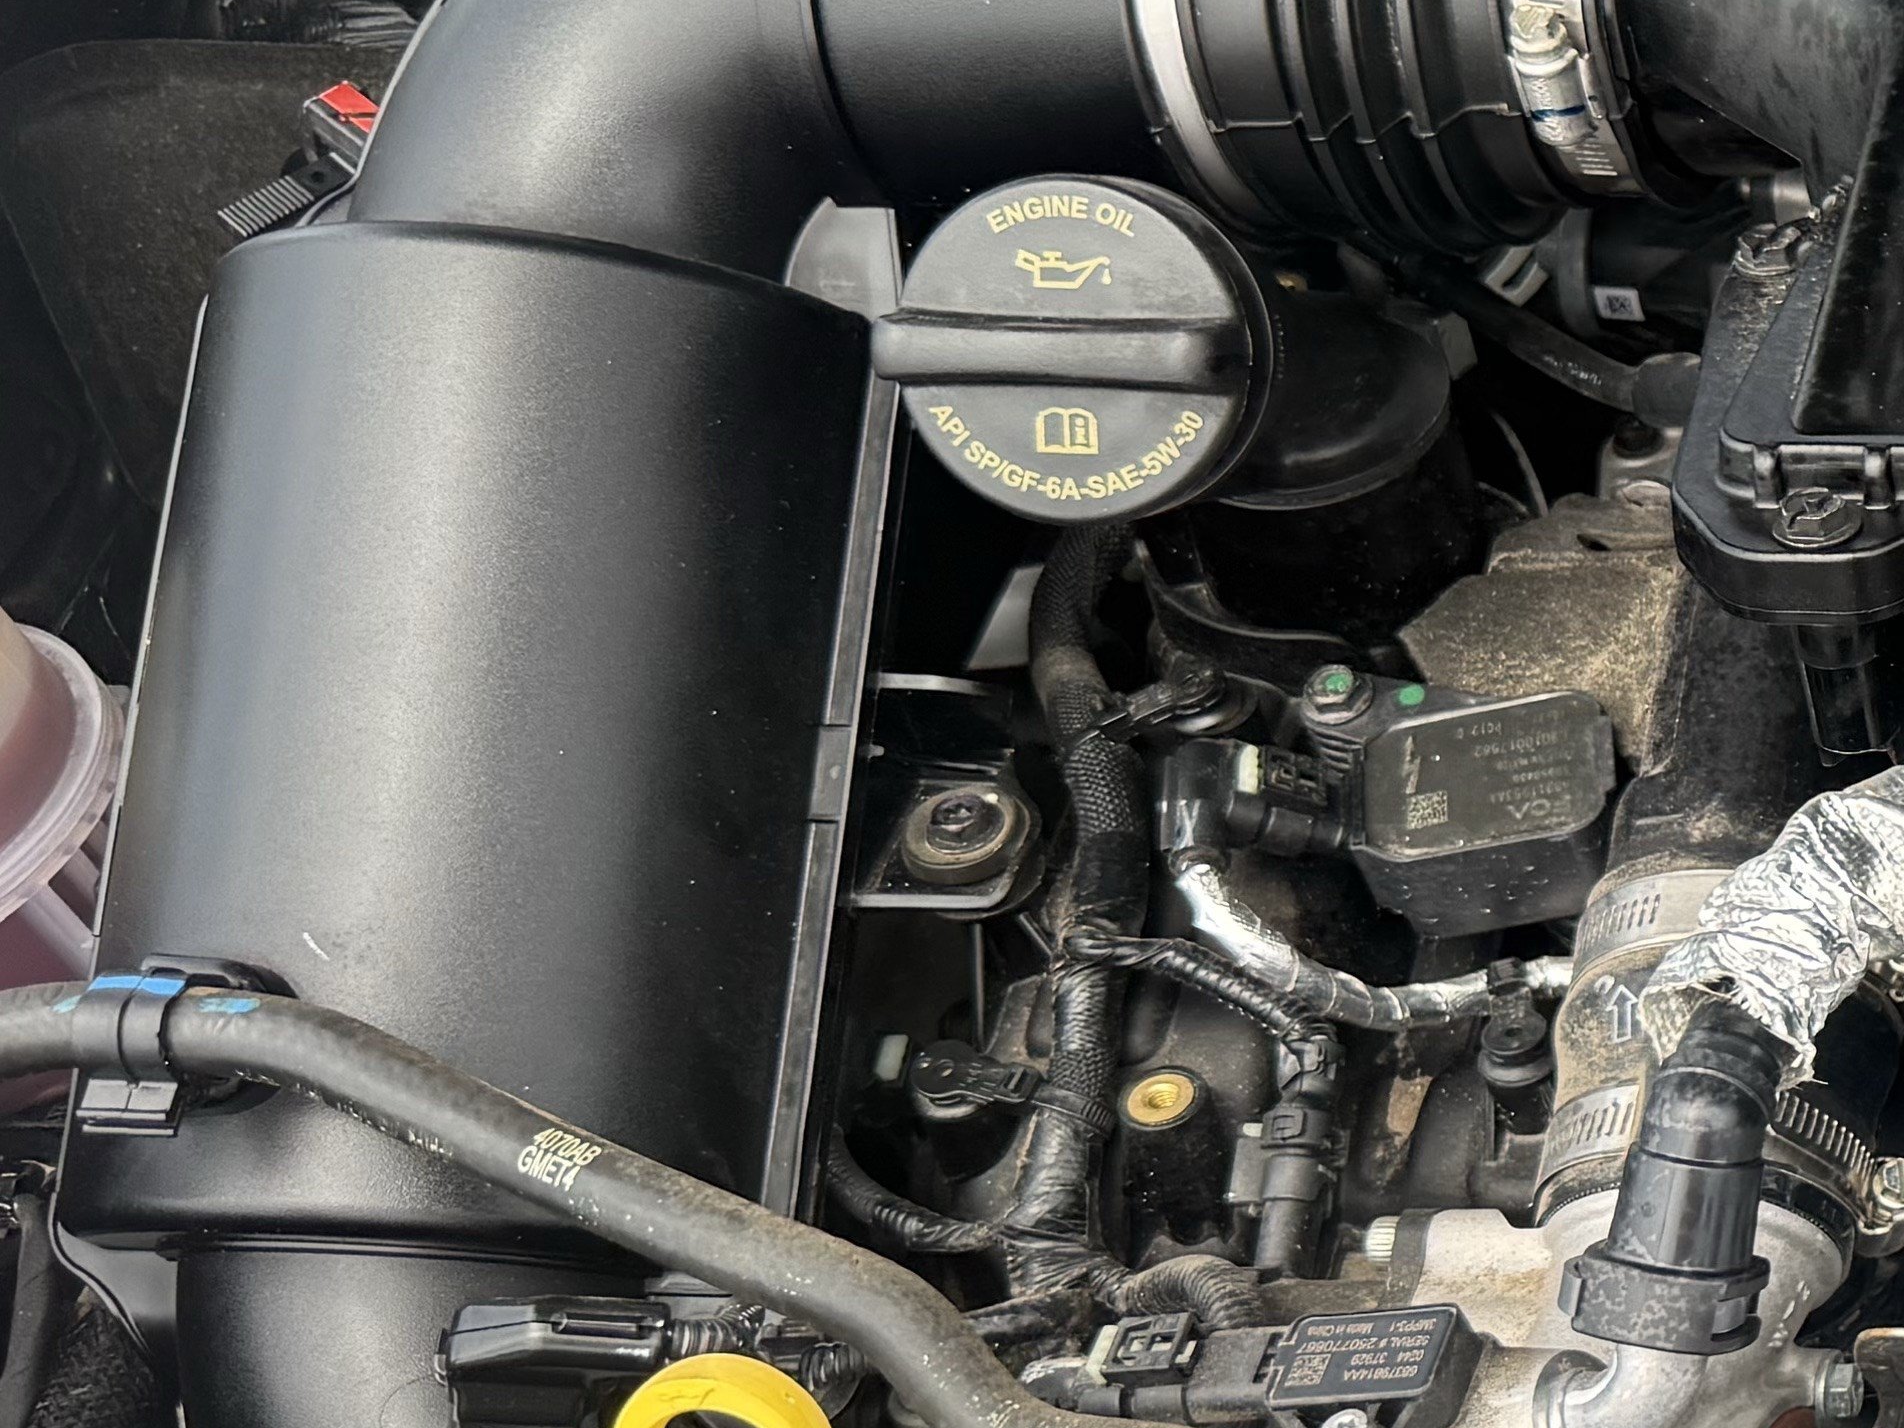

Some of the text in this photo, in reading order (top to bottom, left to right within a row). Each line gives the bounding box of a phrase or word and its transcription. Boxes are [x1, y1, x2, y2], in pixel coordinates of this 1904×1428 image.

[985, 193, 1137, 238] ENGINE OIL
[928, 402, 1205, 502] API SP/GF-6A-SAE-5W-30
[534, 1128, 602, 1166] 4070AB
[518, 1145, 581, 1191] GMET4
[1307, 1324, 1334, 1335] China
[1335, 1324, 1345, 1334] in
[1389, 1334, 1430, 1347] SERIAL
[1377, 1337, 1388, 1348] #
